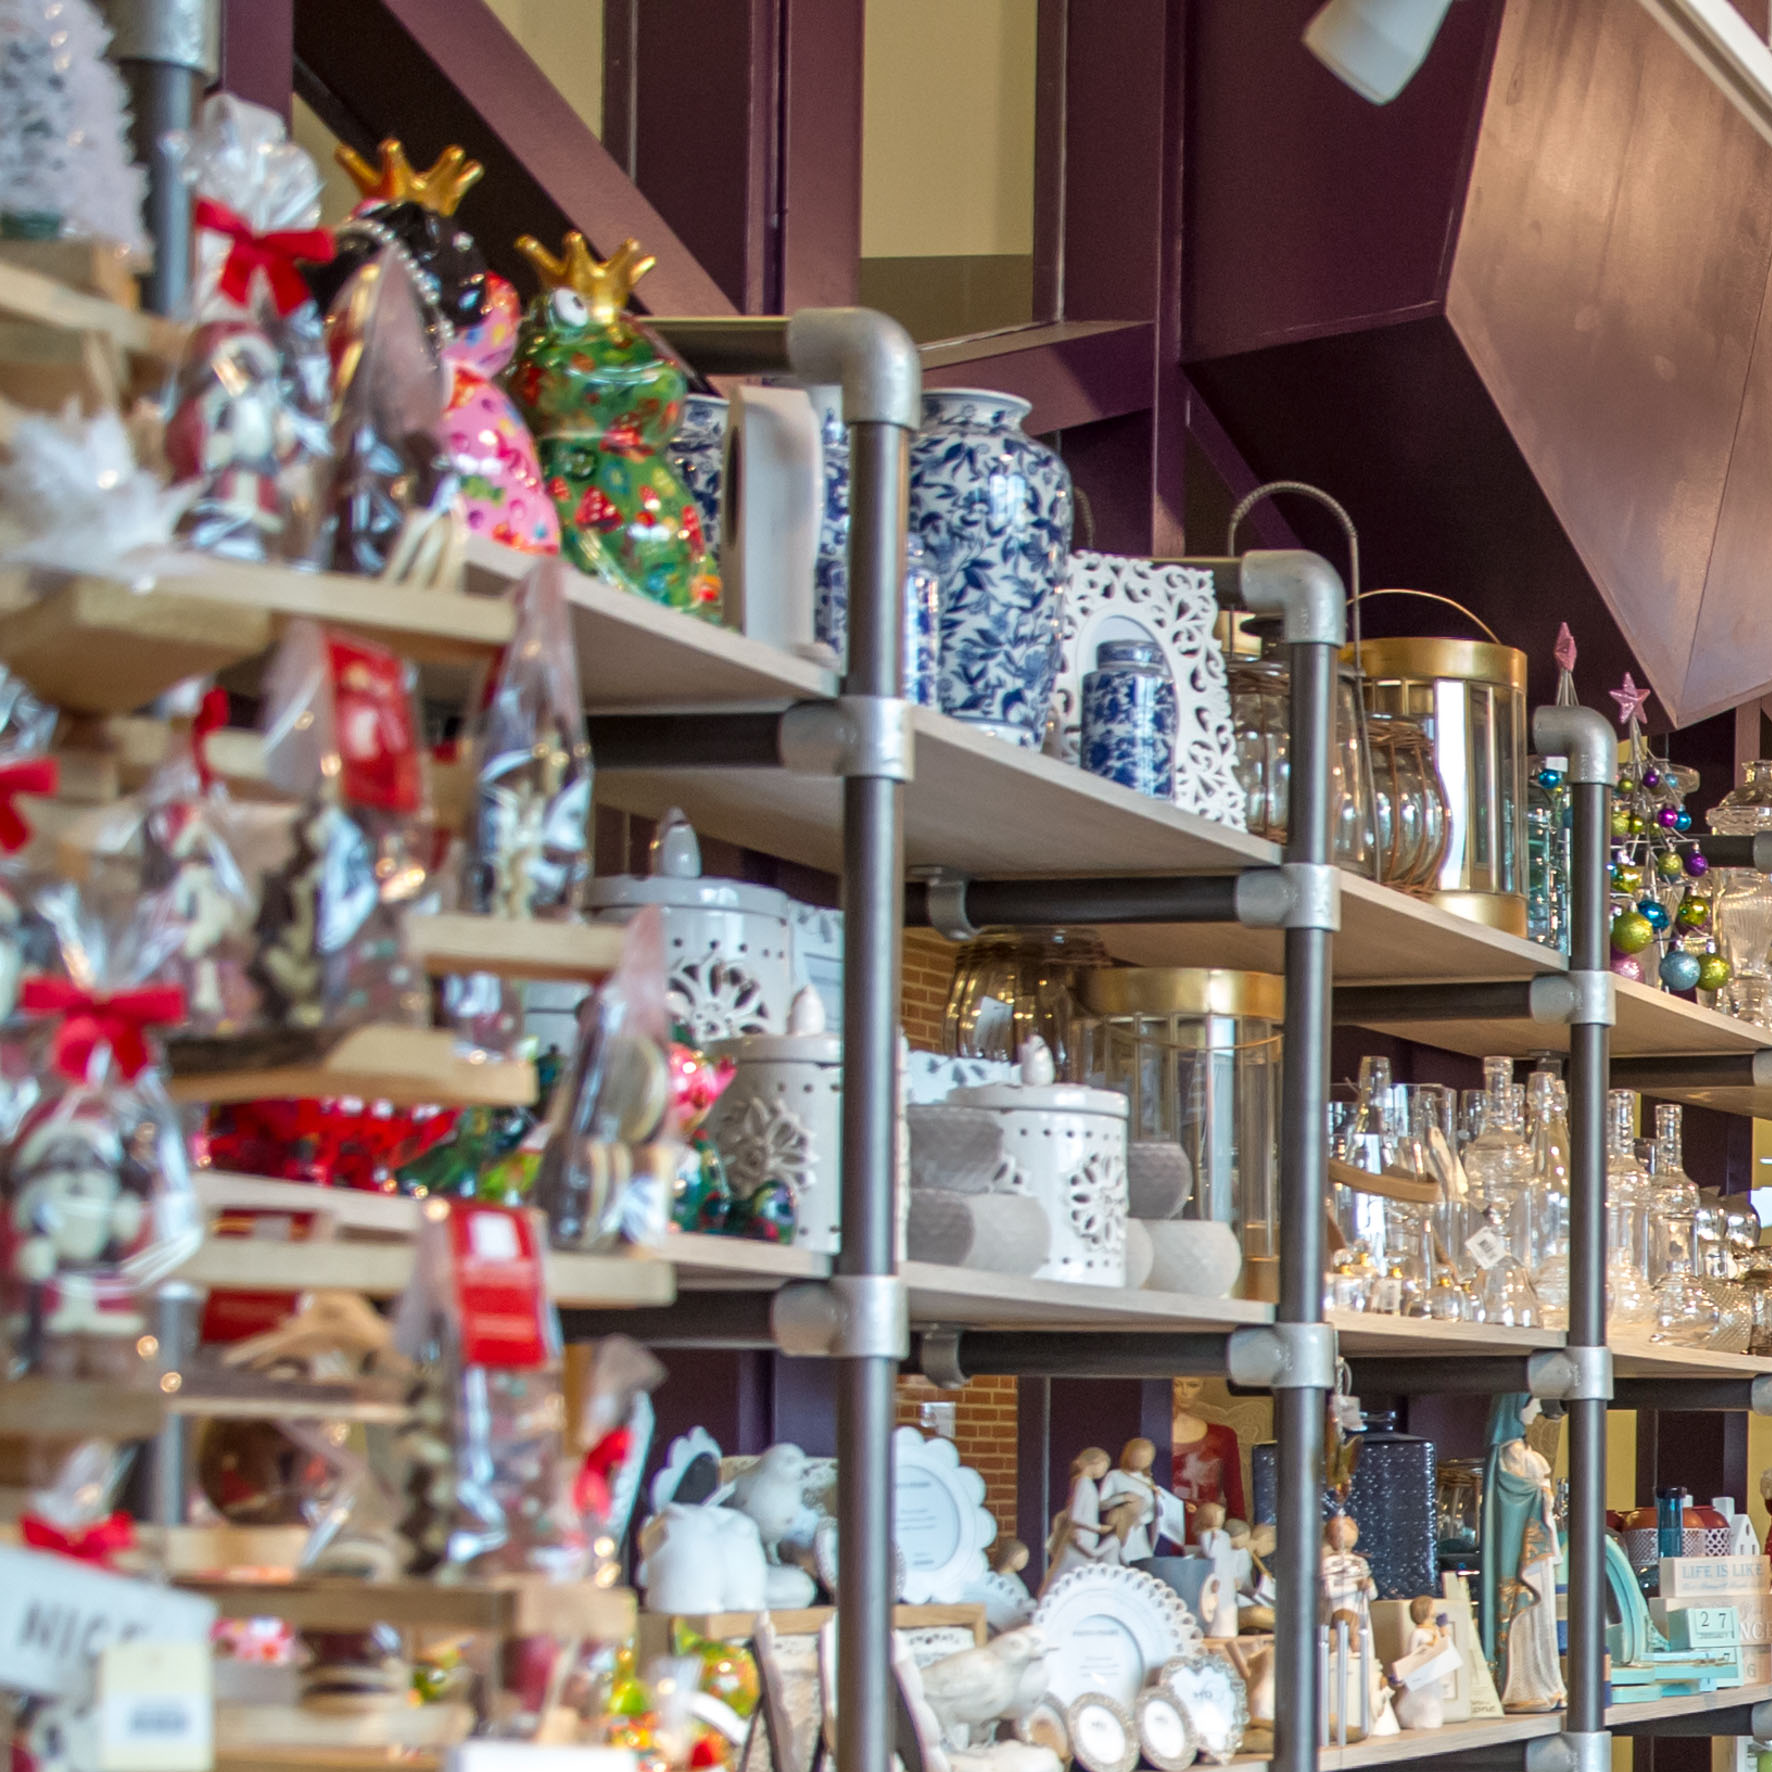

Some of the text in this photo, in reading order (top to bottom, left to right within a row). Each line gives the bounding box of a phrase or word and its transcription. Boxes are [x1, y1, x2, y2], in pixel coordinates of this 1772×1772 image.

[1682, 1563, 1764, 1579] LIFE IS LIKE
